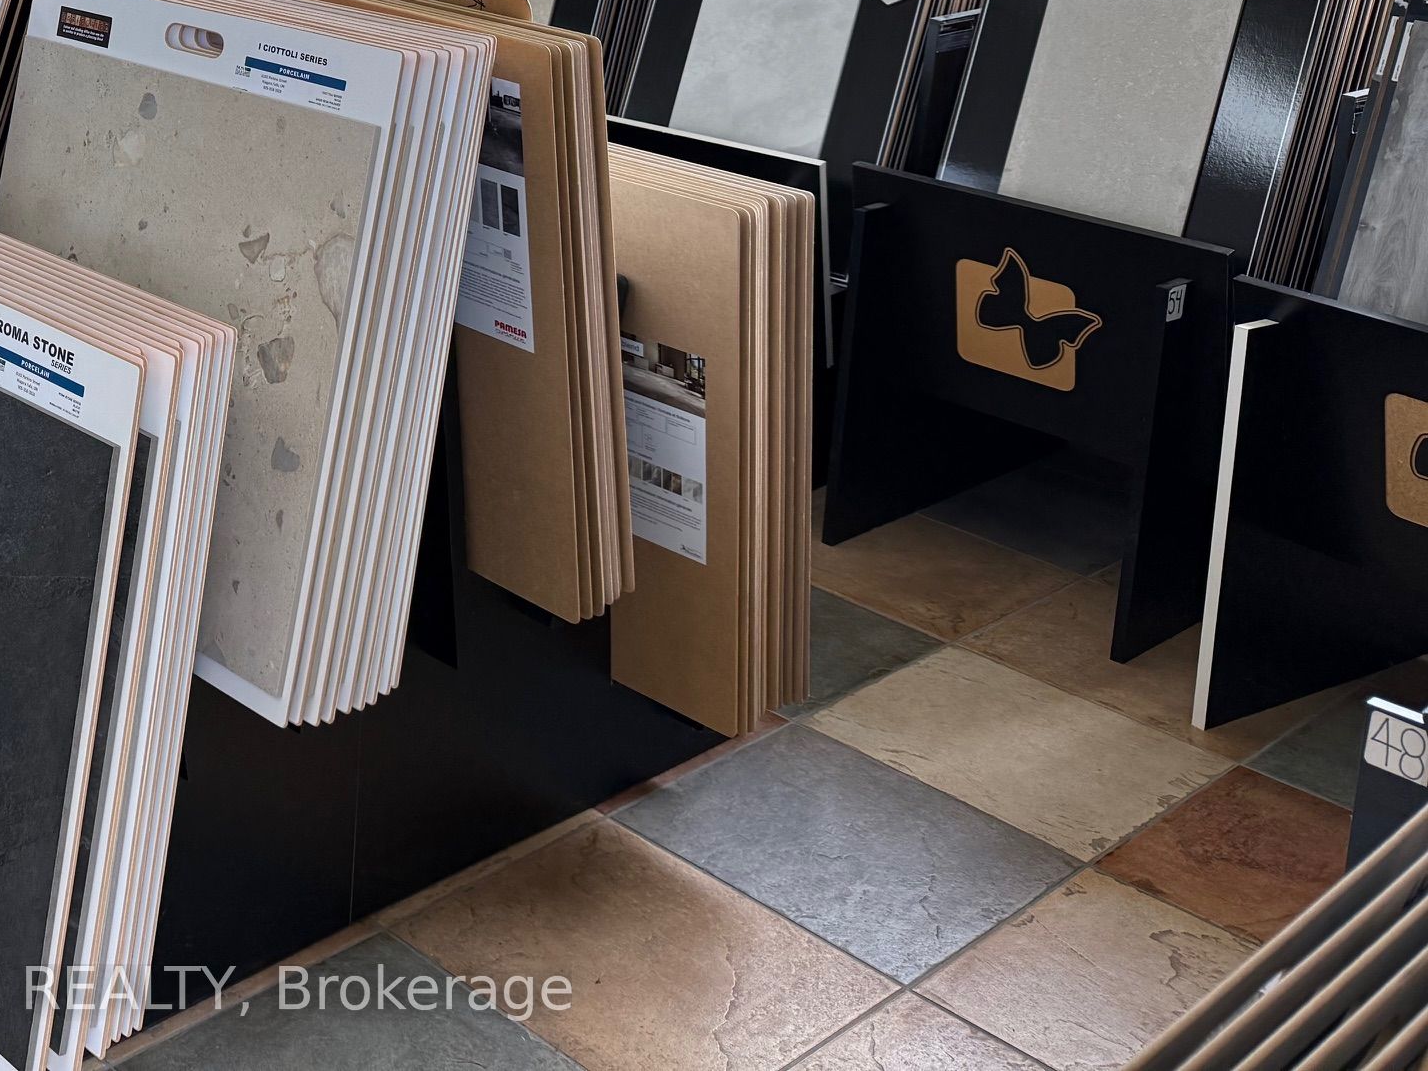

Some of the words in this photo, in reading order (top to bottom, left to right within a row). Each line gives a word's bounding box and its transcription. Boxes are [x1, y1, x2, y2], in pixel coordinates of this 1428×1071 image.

[258, 42, 262, 50] I
[263, 44, 299, 59] CIOTTOLI
[300, 53, 328, 66] SERIES
[279, 67, 310, 80] PORCELAIN
[1168, 289, 1183, 315] 54
[494, 319, 527, 339] PAMESA
[32, 335, 75, 367] STONE
[21, 359, 50, 379] PORCELAIN
[50, 359, 72, 375] SERIES
[1370, 718, 1426, 781] 48
